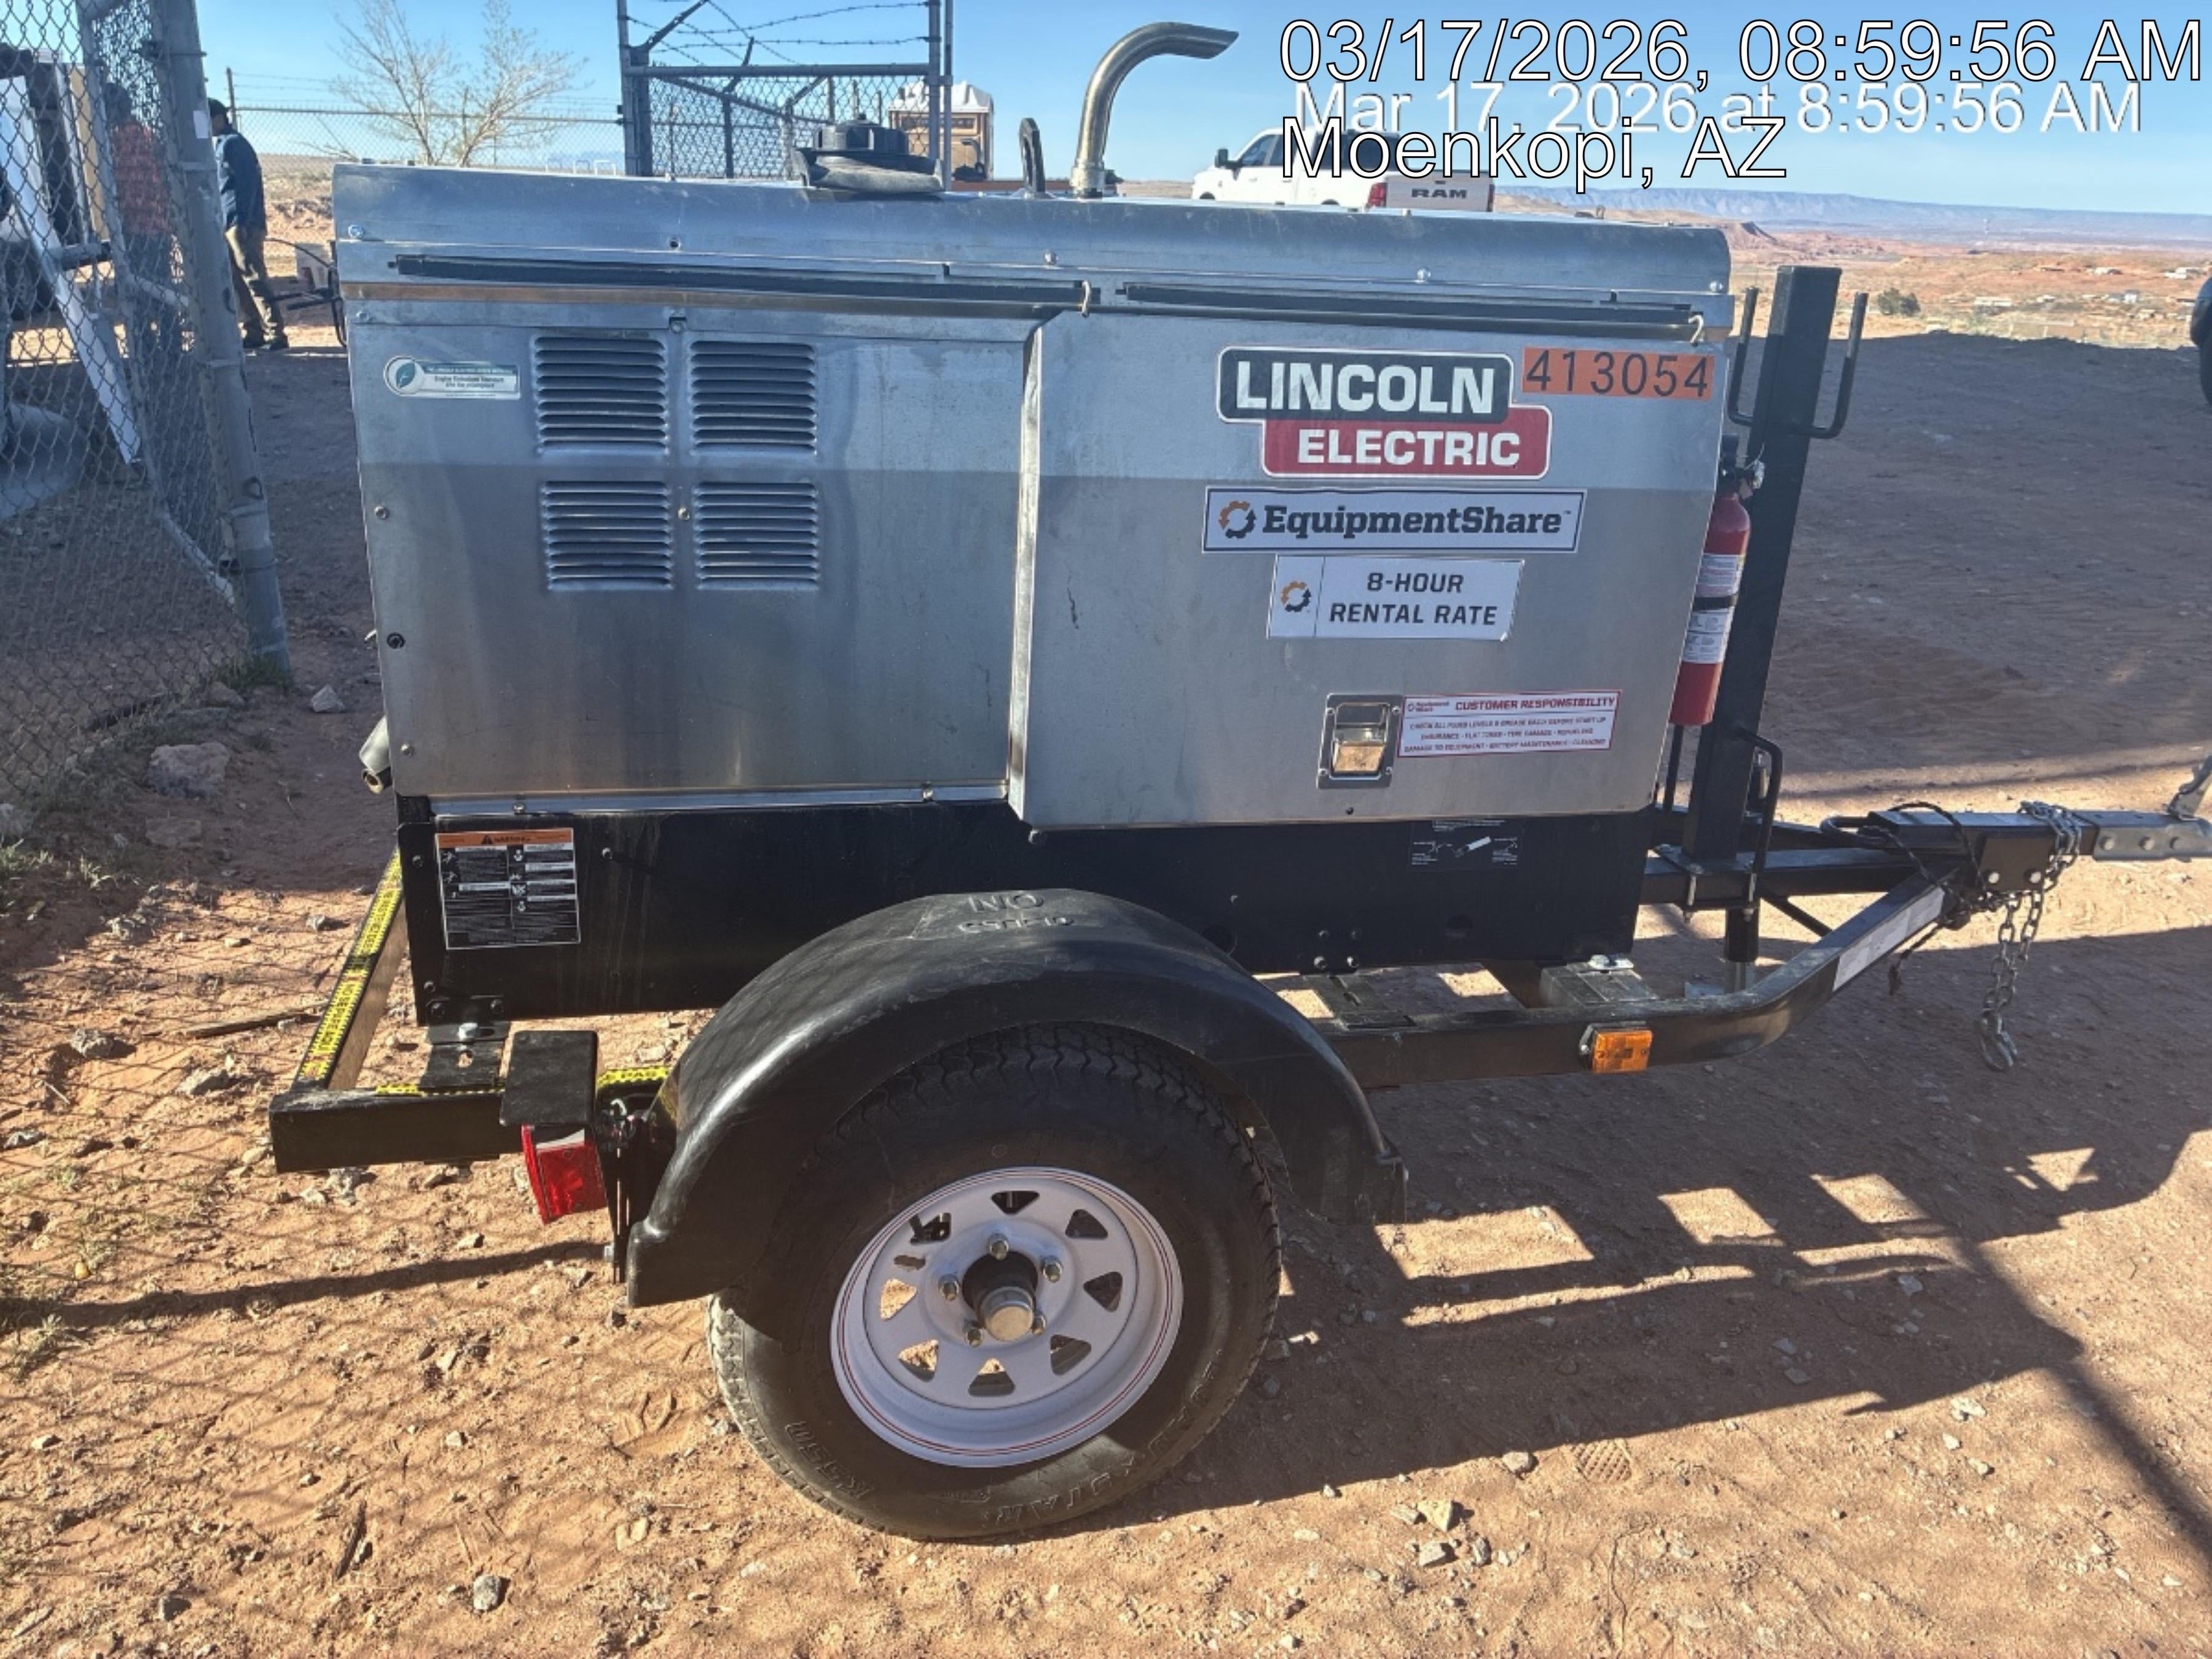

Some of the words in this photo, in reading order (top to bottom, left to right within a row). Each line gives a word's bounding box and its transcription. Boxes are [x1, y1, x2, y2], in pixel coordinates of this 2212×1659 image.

[1411, 189, 1467, 199] RAM
[1526, 348, 1710, 398] 413054
[1236, 361, 1496, 414] LINCOLN
[1298, 428, 1521, 467] ELECTRIC
[1262, 505, 1562, 539] EquipmentShare
[1367, 572, 1464, 594] 8-HOUR
[1329, 602, 1425, 624] RENTAL
[1433, 605, 1497, 626] RATE
[1456, 699, 1518, 711] CUSTOMER
[1521, 697, 1615, 708] RESPONSIBILITY
[967, 893, 1045, 913] NO
